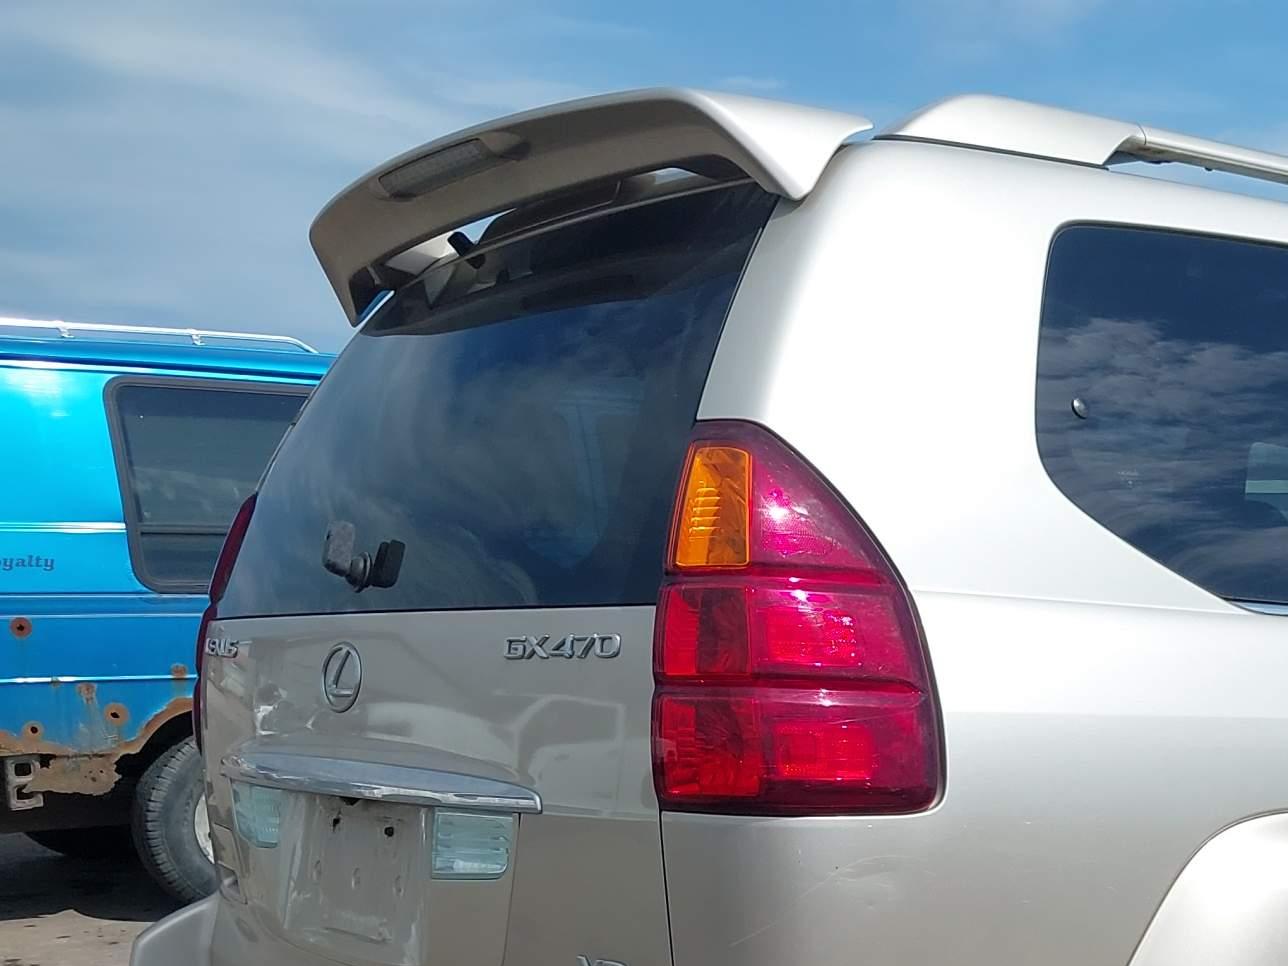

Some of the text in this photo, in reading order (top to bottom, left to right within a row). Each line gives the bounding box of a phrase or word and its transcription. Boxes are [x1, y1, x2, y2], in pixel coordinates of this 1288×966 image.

[0, 554, 55, 572] yalty
[205, 637, 240, 659] EXUS
[503, 632, 621, 660] GX470
